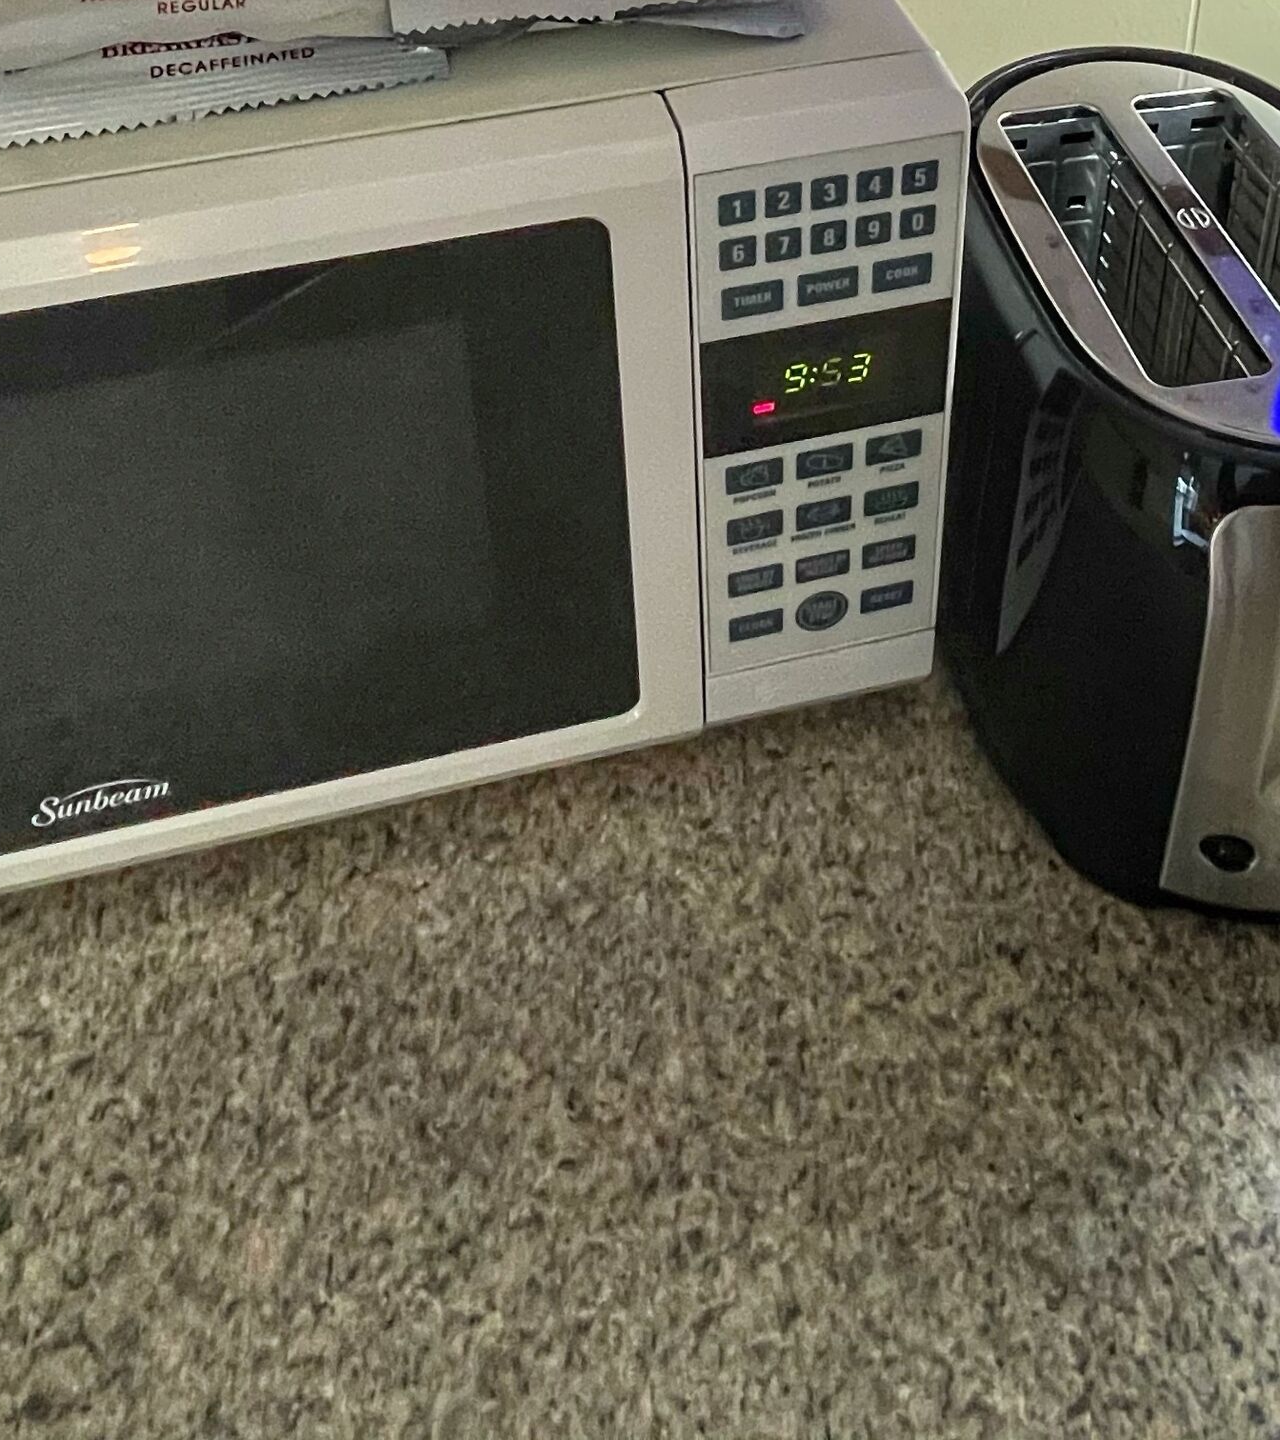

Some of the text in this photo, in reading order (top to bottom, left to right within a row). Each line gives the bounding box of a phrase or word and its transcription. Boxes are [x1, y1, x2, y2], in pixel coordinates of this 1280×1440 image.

[150, 47, 315, 79] DECAFFEINATED
[732, 168, 926, 218] 1 2 3 4 5
[732, 213, 924, 262] 6 7 8 9 0
[806, 277, 850, 295] POWER
[784, 352, 871, 394] 9:53
[31, 780, 170, 827] Sunbeam
